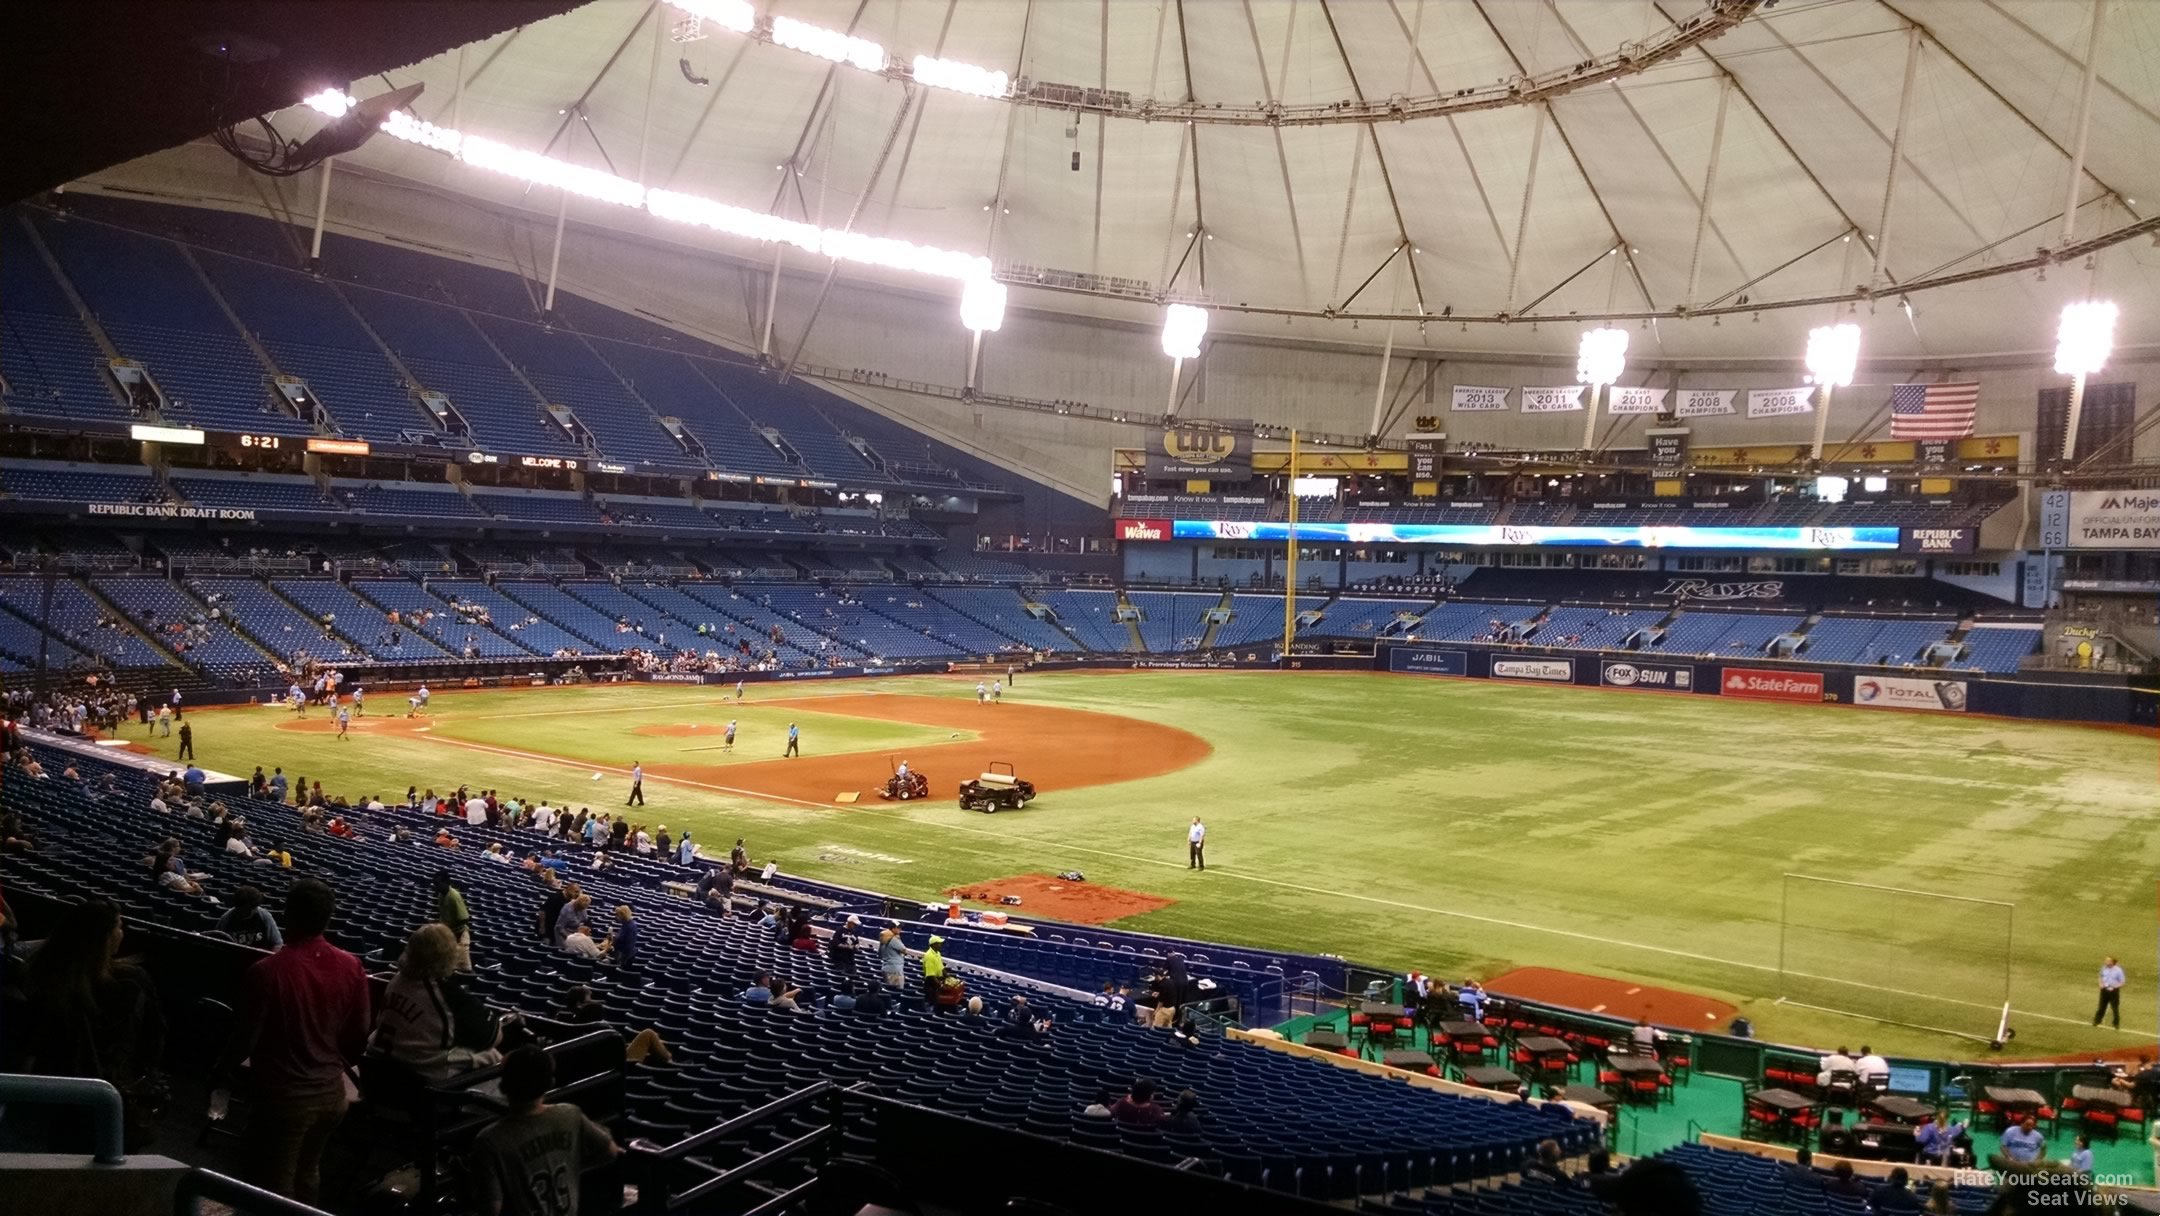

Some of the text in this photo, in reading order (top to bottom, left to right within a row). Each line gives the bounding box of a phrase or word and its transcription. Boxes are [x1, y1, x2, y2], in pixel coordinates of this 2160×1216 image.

[1466, 394, 1495, 403] 2013
[1537, 394, 1566, 404] 2011
[1622, 396, 1652, 404] 2010
[1688, 398, 1720, 407] 2008
[1763, 398, 1796, 407] 2008
[1680, 406, 1728, 414] CHAMPIONS
[1752, 405, 1805, 414] CHAMPIONS
[241, 435, 279, 448] 6:21
[1656, 438, 1678, 446] Have
[1658, 448, 1676, 456] you
[1926, 447, 1944, 456] you
[522, 457, 576, 469] WELCOME TO
[1224, 496, 1265, 504] tampabay.com
[2047, 495, 2064, 508] 42
[2123, 496, 2160, 512] Maje
[89, 504, 255, 519] REPUBLIC BANK DRAFT ROOM
[2048, 514, 2060, 526] 12
[1124, 526, 1161, 539] Wawa
[1913, 530, 1962, 539] REPUBLIC
[2083, 528, 2160, 538] TAMPA BAY
[2044, 532, 2062, 544] 66
[1922, 539, 1952, 548] BANK
[1412, 654, 1444, 663] JABIL
[1498, 664, 1567, 677] Tampa Bay Times
[1612, 668, 1632, 679] FOX
[1640, 669, 1668, 684] SUN
[1885, 686, 1934, 699] TOTAL
